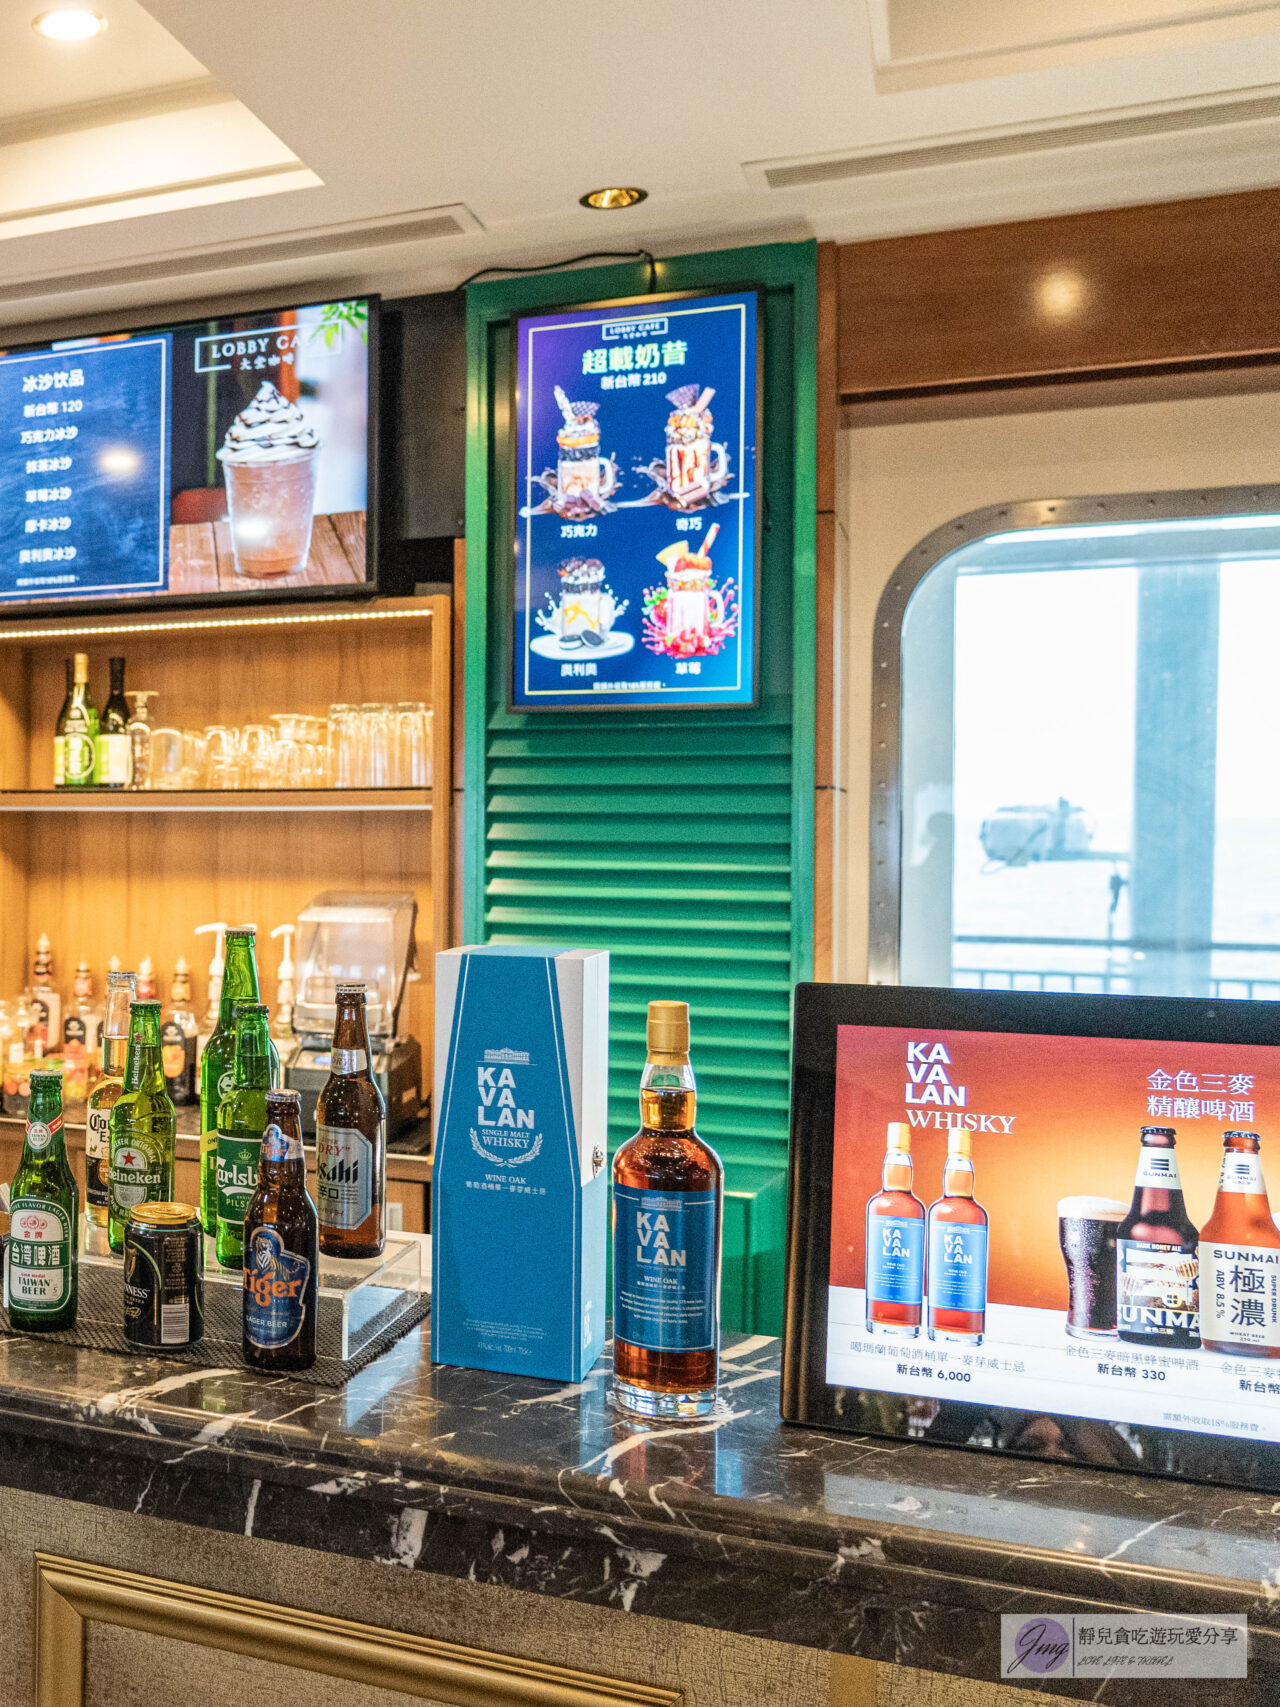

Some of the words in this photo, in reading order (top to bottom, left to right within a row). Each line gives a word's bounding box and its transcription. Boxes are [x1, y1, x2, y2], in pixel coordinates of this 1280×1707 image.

[211, 337, 269, 359] LOBBY
[642, 371, 667, 386] 210
[61, 399, 83, 413] 120
[560, 524, 598, 538] 巧克力
[906, 1041, 951, 1065] KA
[131, 1044, 141, 1086] Heineken
[905, 1062, 951, 1086] VA
[477, 1066, 517, 1090] KA
[1146, 1068, 1255, 1096] 金色三麥
[477, 1085, 517, 1110] VA
[905, 1083, 967, 1107] LAN
[477, 1105, 535, 1130] LAN
[1146, 1094, 1255, 1123] 精釀啤酒
[906, 1109, 1017, 1135] WHISKY
[481, 1128, 508, 1137] SINGLE
[509, 1130, 531, 1138] MALT
[482, 1135, 530, 1149] WHISKY
[108, 1166, 162, 1185] Heineken
[216, 1156, 259, 1188] Carlsb
[318, 1159, 359, 1184] sahi
[484, 1173, 507, 1183] WINE
[508, 1176, 527, 1185] OAK
[1142, 1170, 1178, 1179] SUNMAI
[21, 1201, 46, 1210] FLAVOR
[225, 1197, 250, 1208] PILS
[636, 1211, 671, 1233] KA
[23, 1230, 43, 1239] 金牌
[636, 1228, 670, 1250] VA
[882, 1228, 902, 1239] KA
[882, 1237, 902, 1248] VA
[943, 1234, 964, 1245] KA
[636, 1245, 687, 1267] LAN
[882, 1246, 910, 1258] LAN
[944, 1244, 964, 1255] VA
[1152, 1243, 1171, 1251] HONEY
[1171, 1244, 1182, 1252] ALE
[1213, 1249, 1279, 1264] SUNMAI
[943, 1253, 973, 1265] LAN
[18, 1276, 51, 1288] TAIWAN
[243, 1268, 302, 1307] Tiger
[644, 1275, 662, 1284] WINE
[662, 1277, 678, 1285] OAK
[1216, 1269, 1225, 1290] ABV
[21, 1286, 47, 1296] BEER
[1229, 1265, 1267, 1328] 極濃
[245, 1314, 265, 1327] LAGER
[266, 1318, 288, 1328] BEER
[1117, 1304, 1200, 1329] SUNMA
[1064, 1344, 1200, 1371] 金色三麥暗黑蜂蜜啤酒
[896, 1363, 933, 1379] 新台幣
[937, 1370, 971, 1383] 6,000
[1096, 1363, 1137, 1379] 新台幣
[1141, 1369, 1166, 1381] 330
[1239, 1379, 1280, 1395] 新台幣
